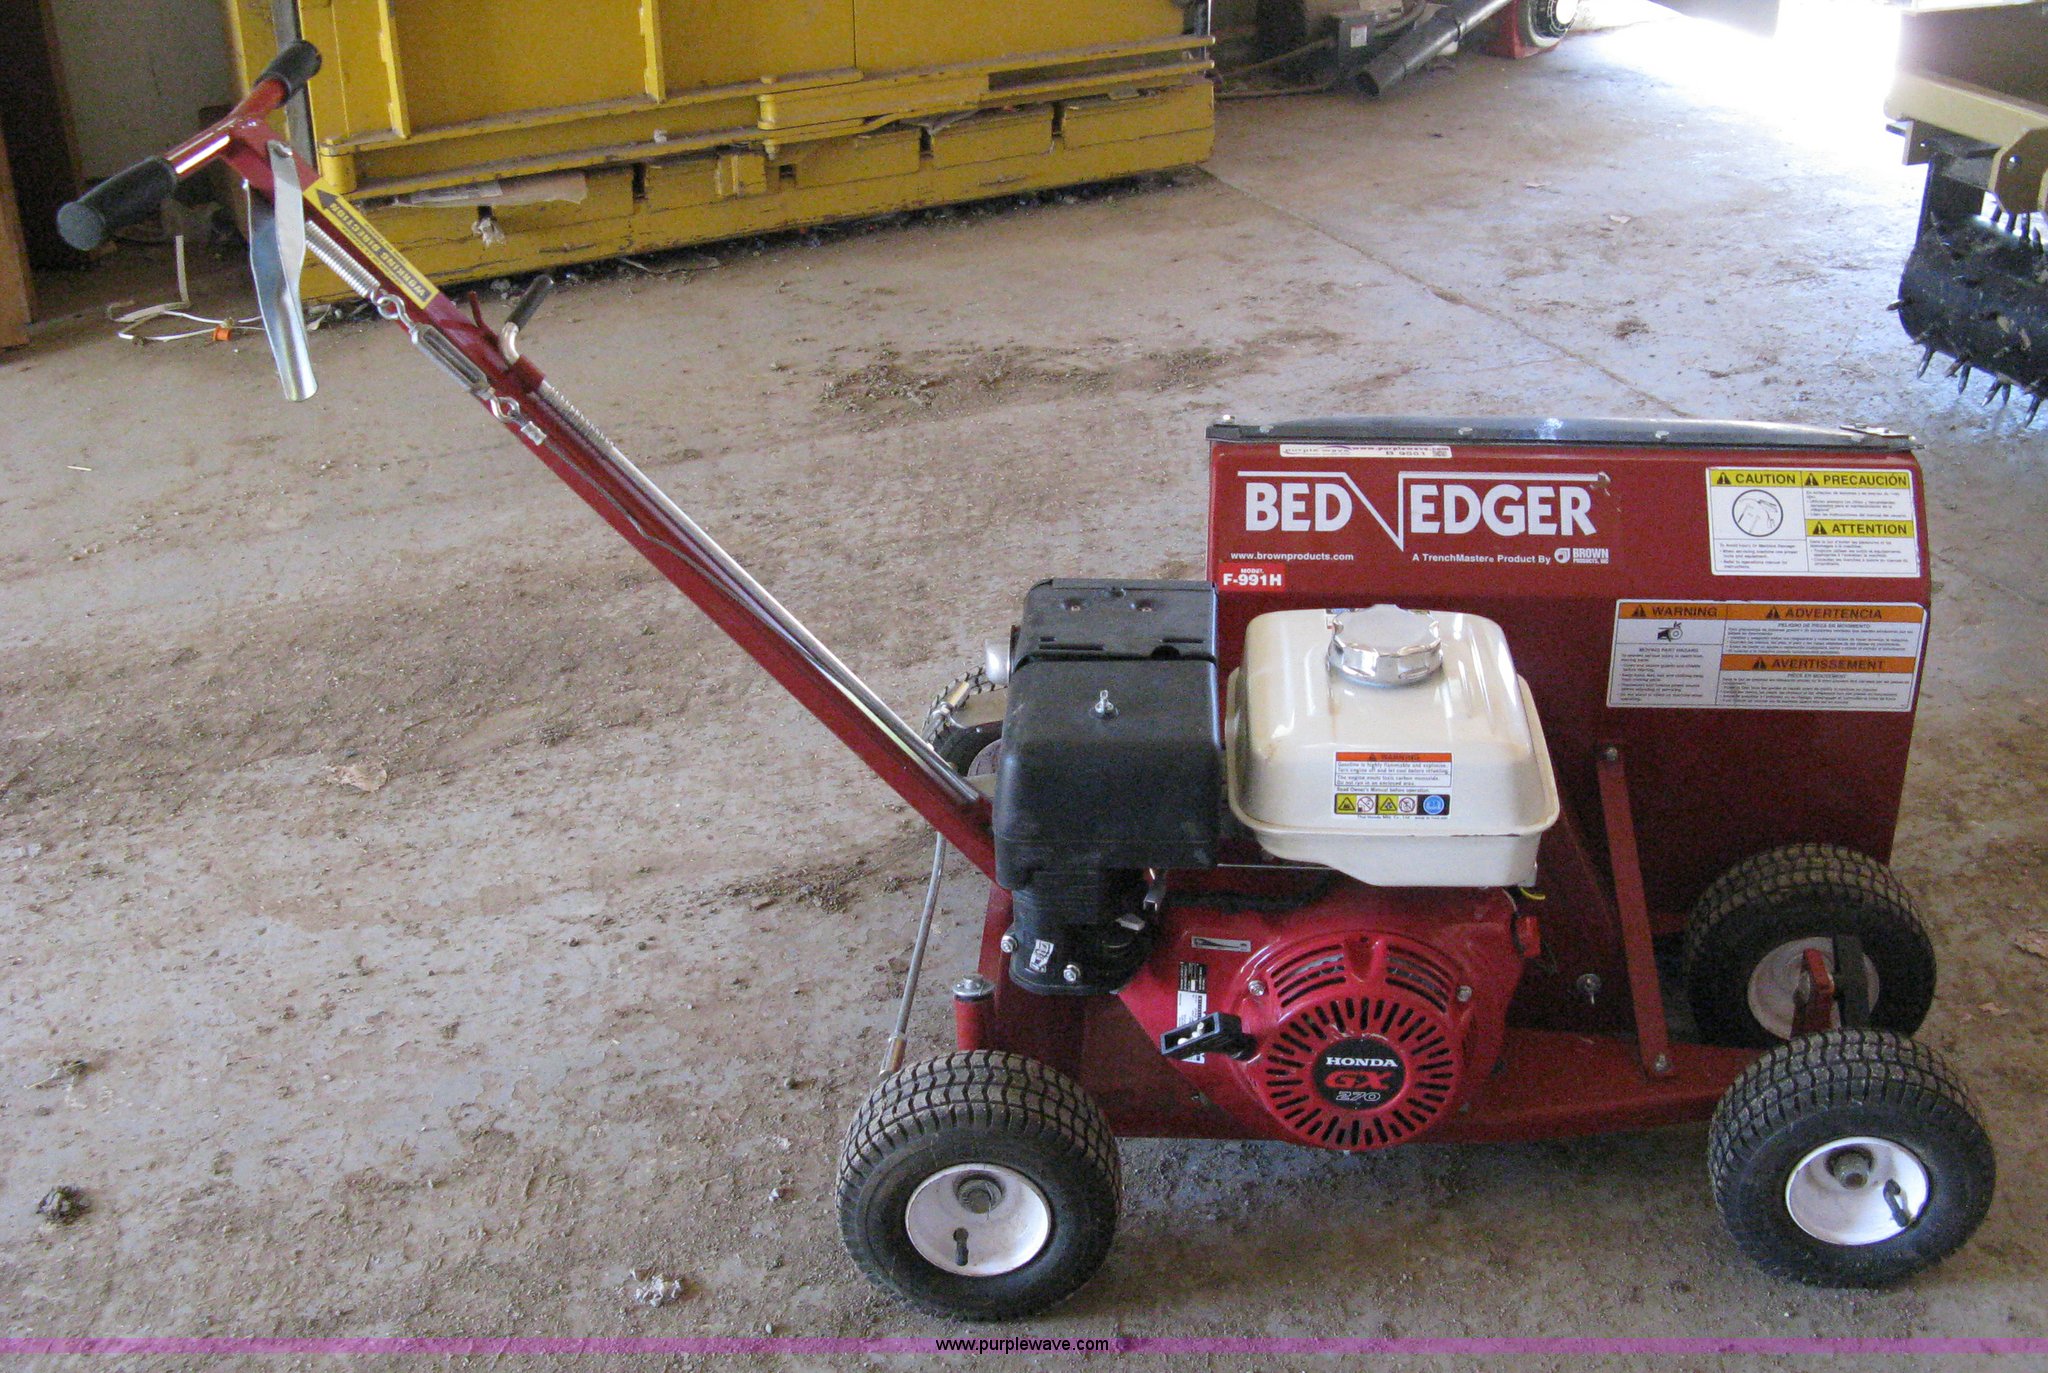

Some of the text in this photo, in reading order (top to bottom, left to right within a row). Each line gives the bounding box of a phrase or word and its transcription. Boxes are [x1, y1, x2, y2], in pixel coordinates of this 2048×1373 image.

[328, 200, 381, 253] DIRECTION
[379, 250, 426, 297] WORKING
[1735, 474, 1796, 485] CAUTION
[1823, 473, 1907, 486] PRECAUCIÓN
[1245, 482, 1597, 537] BED EDGER
[1831, 523, 1907, 535] ATTENTION
[1230, 551, 1354, 562] www.brownproducts.com
[1412, 553, 1420, 562] A
[1497, 554, 1535, 564] Product
[1538, 555, 1551, 565] By
[1572, 548, 1609, 559] BROWN
[1222, 573, 1282, 586] F-991H
[1651, 606, 1718, 618] WARNING
[1785, 608, 1882, 620] ADVERTENCIA
[1771, 659, 1886, 671] AVERTISSEMENT
[1326, 1057, 1398, 1067] HONDA
[1324, 1070, 1394, 1090] GX
[1336, 1090, 1381, 1101] 270
